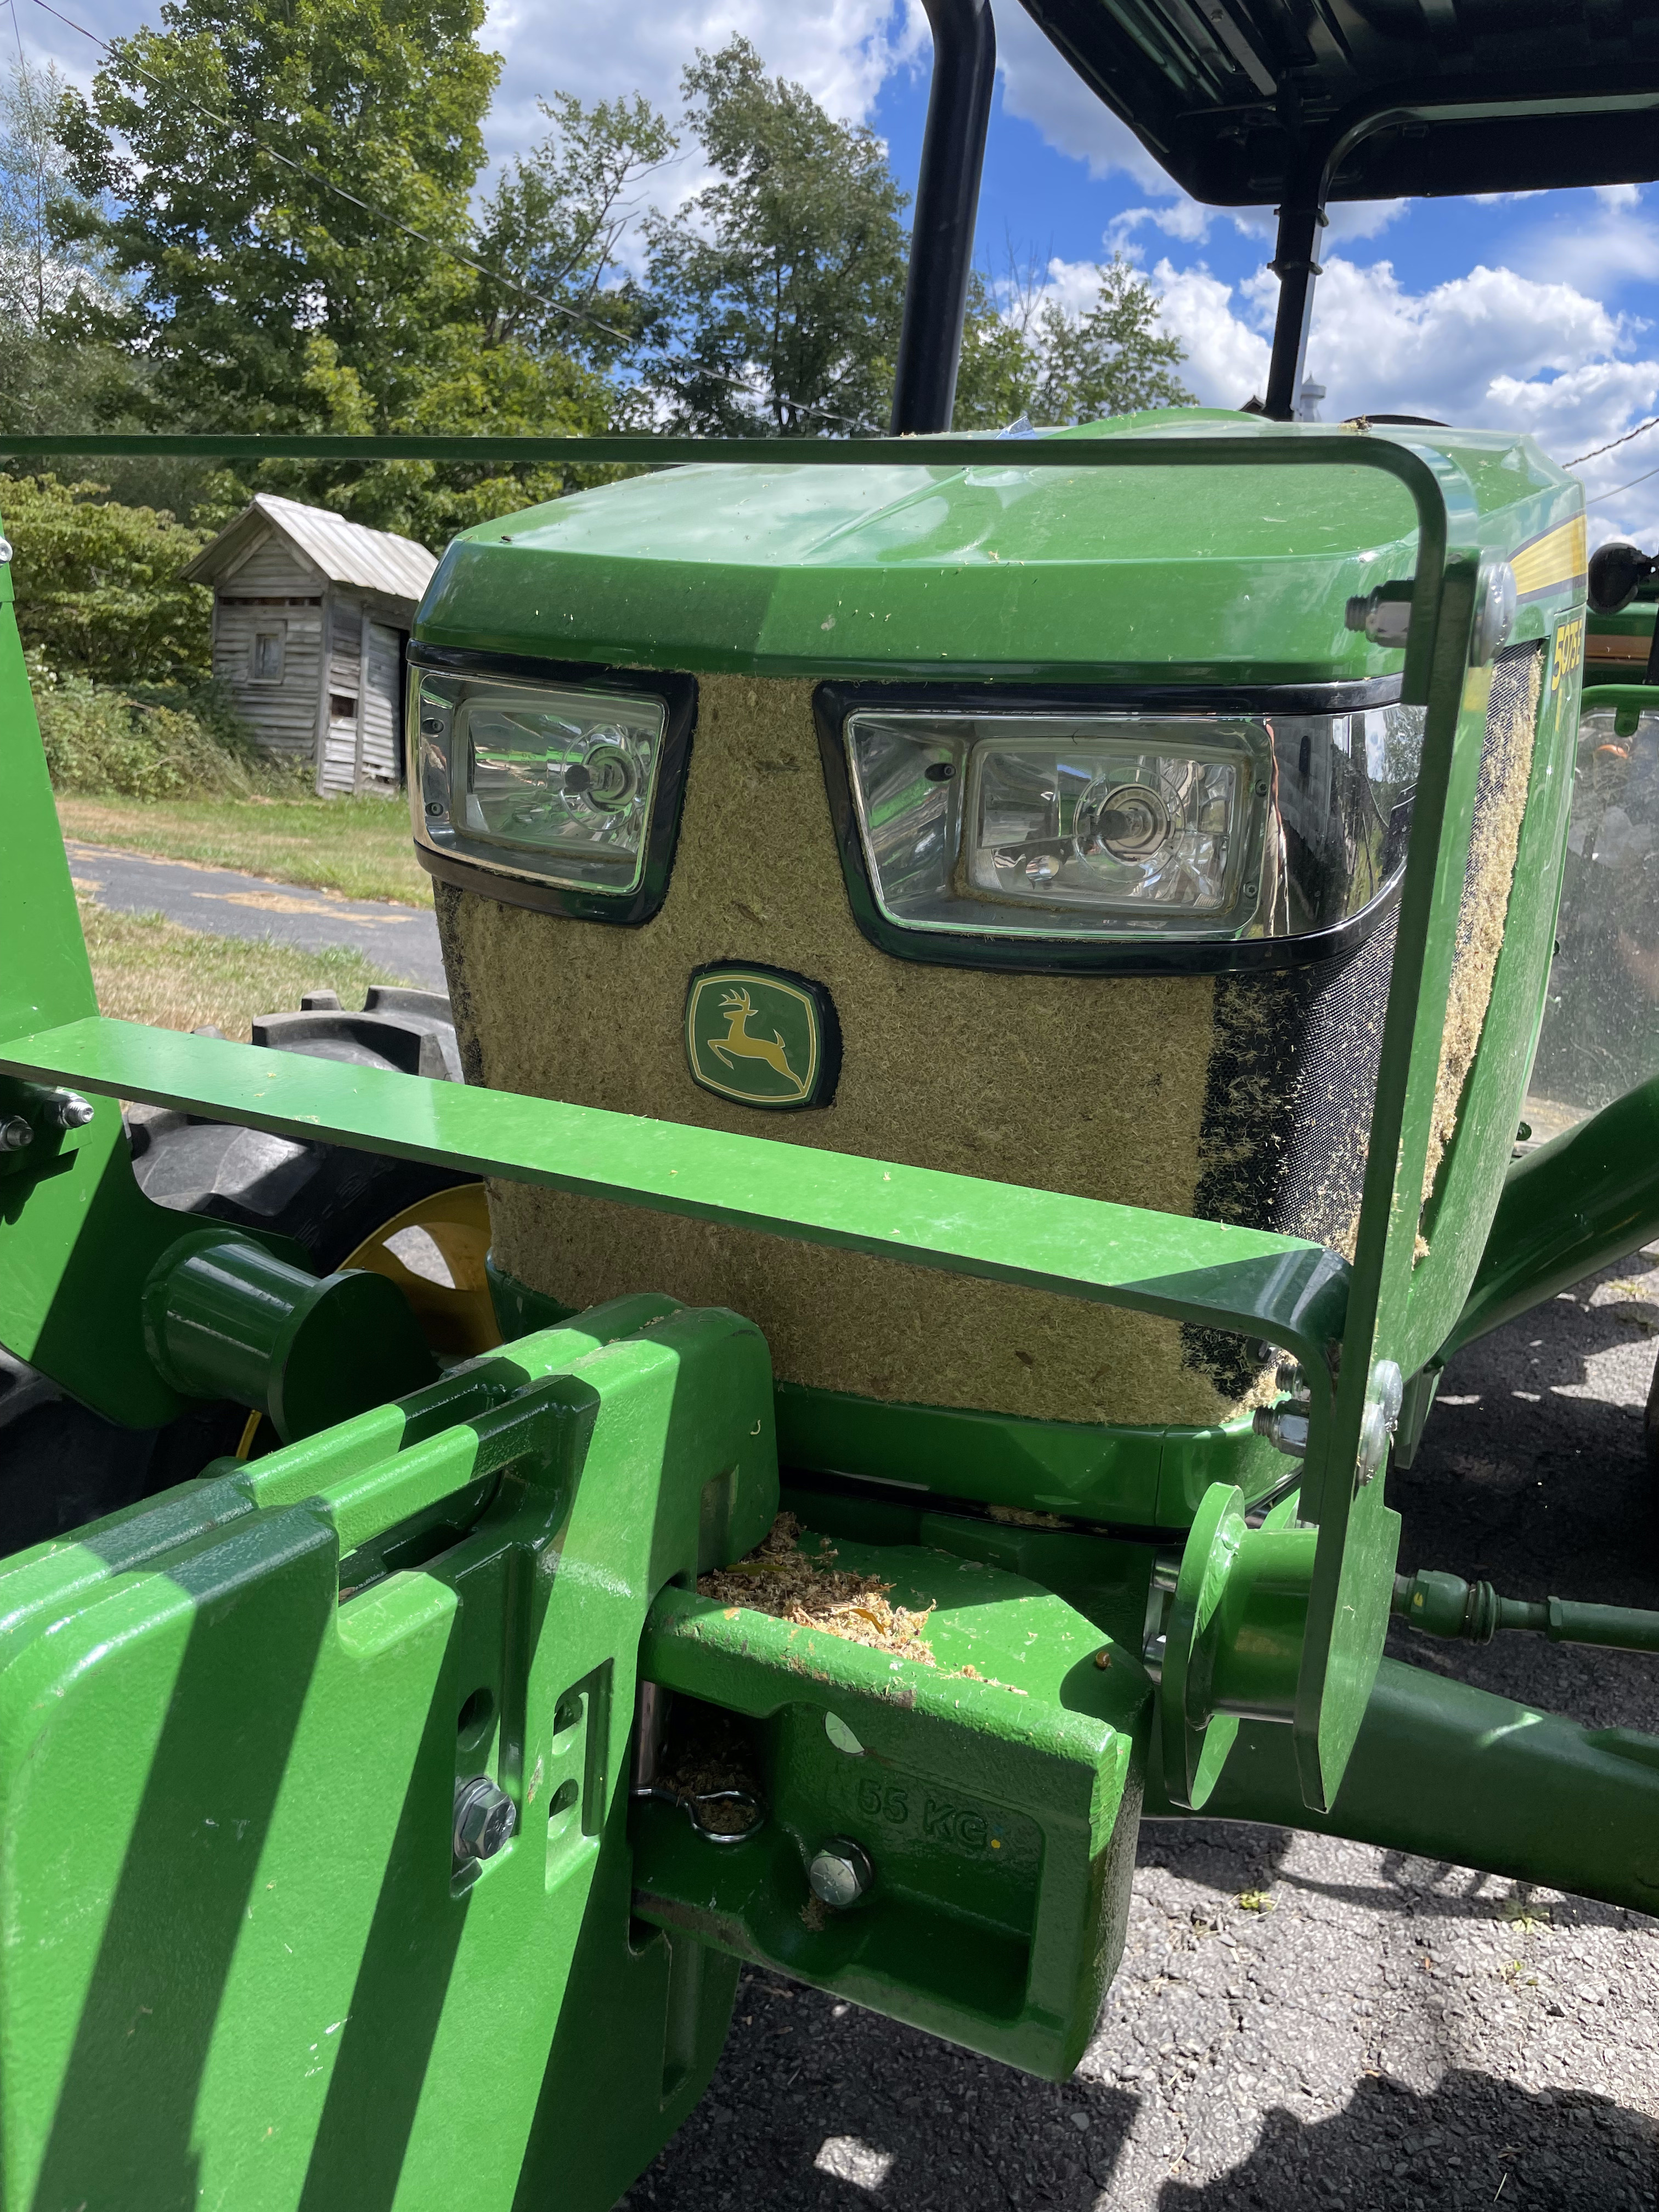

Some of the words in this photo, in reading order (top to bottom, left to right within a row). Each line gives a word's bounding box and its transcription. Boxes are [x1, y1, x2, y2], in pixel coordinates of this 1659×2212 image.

[1551, 618, 1583, 692] 5075E
[857, 1778, 909, 1824] 55
[922, 1798, 988, 1851] KG
